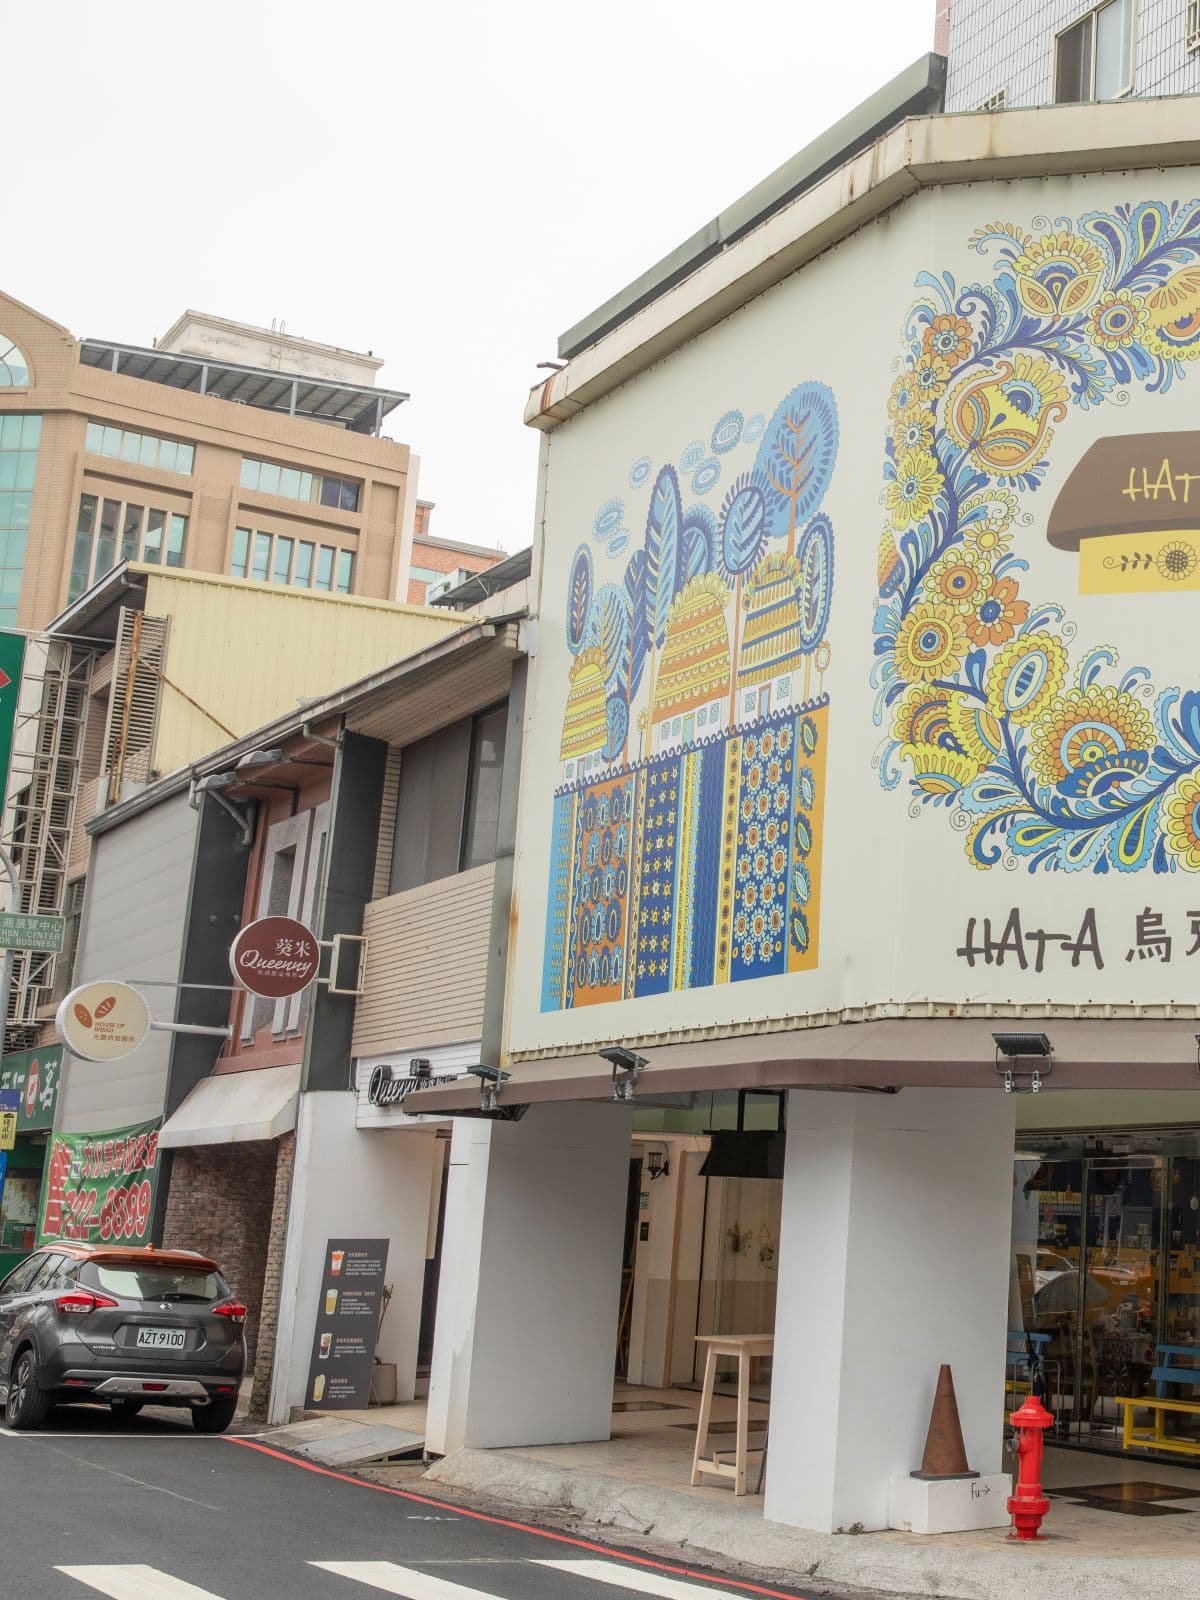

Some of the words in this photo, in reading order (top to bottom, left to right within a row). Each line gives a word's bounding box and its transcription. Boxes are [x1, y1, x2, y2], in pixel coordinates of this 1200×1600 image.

[956, 907, 1105, 973] HATA
[240, 949, 313, 978] Queenny
[138, 1332, 184, 1346] AZT-9100
